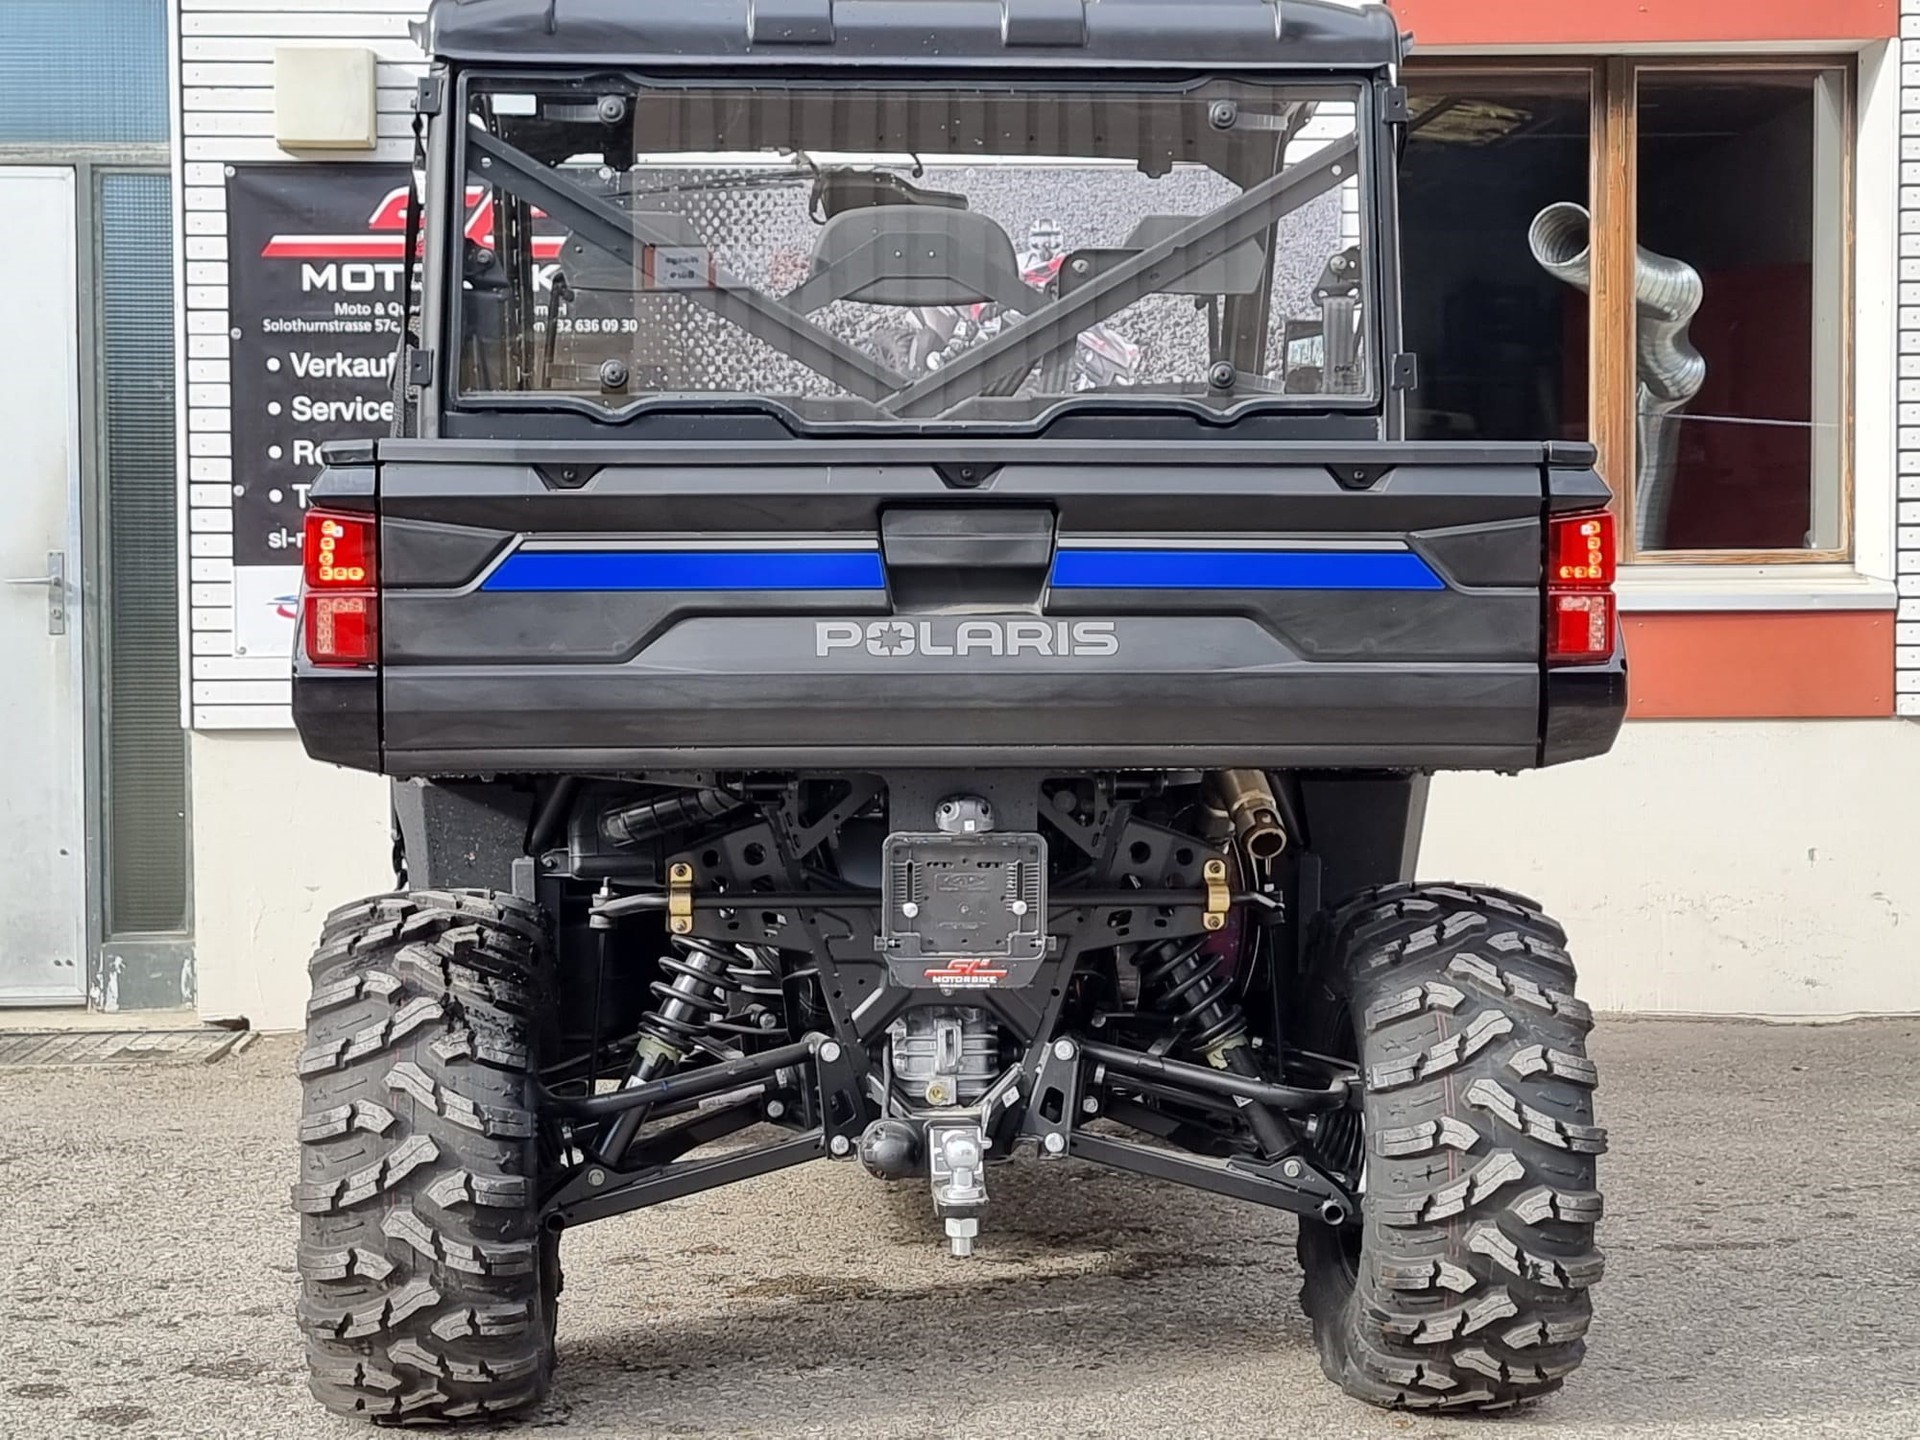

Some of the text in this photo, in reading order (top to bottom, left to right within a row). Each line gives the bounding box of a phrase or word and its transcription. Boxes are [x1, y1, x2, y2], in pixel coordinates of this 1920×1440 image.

[334, 302, 372, 316] Moto
[374, 302, 385, 316] &
[263, 318, 372, 332] Solothurnstrasse
[574, 319, 600, 333] 636
[601, 319, 619, 333] 09
[620, 319, 638, 333] 30
[289, 352, 398, 378] Verkauf
[291, 396, 394, 422] Service
[291, 483, 312, 509] T
[814, 621, 1120, 657] POLARIS
[932, 975, 998, 984] MOTORBIKE
